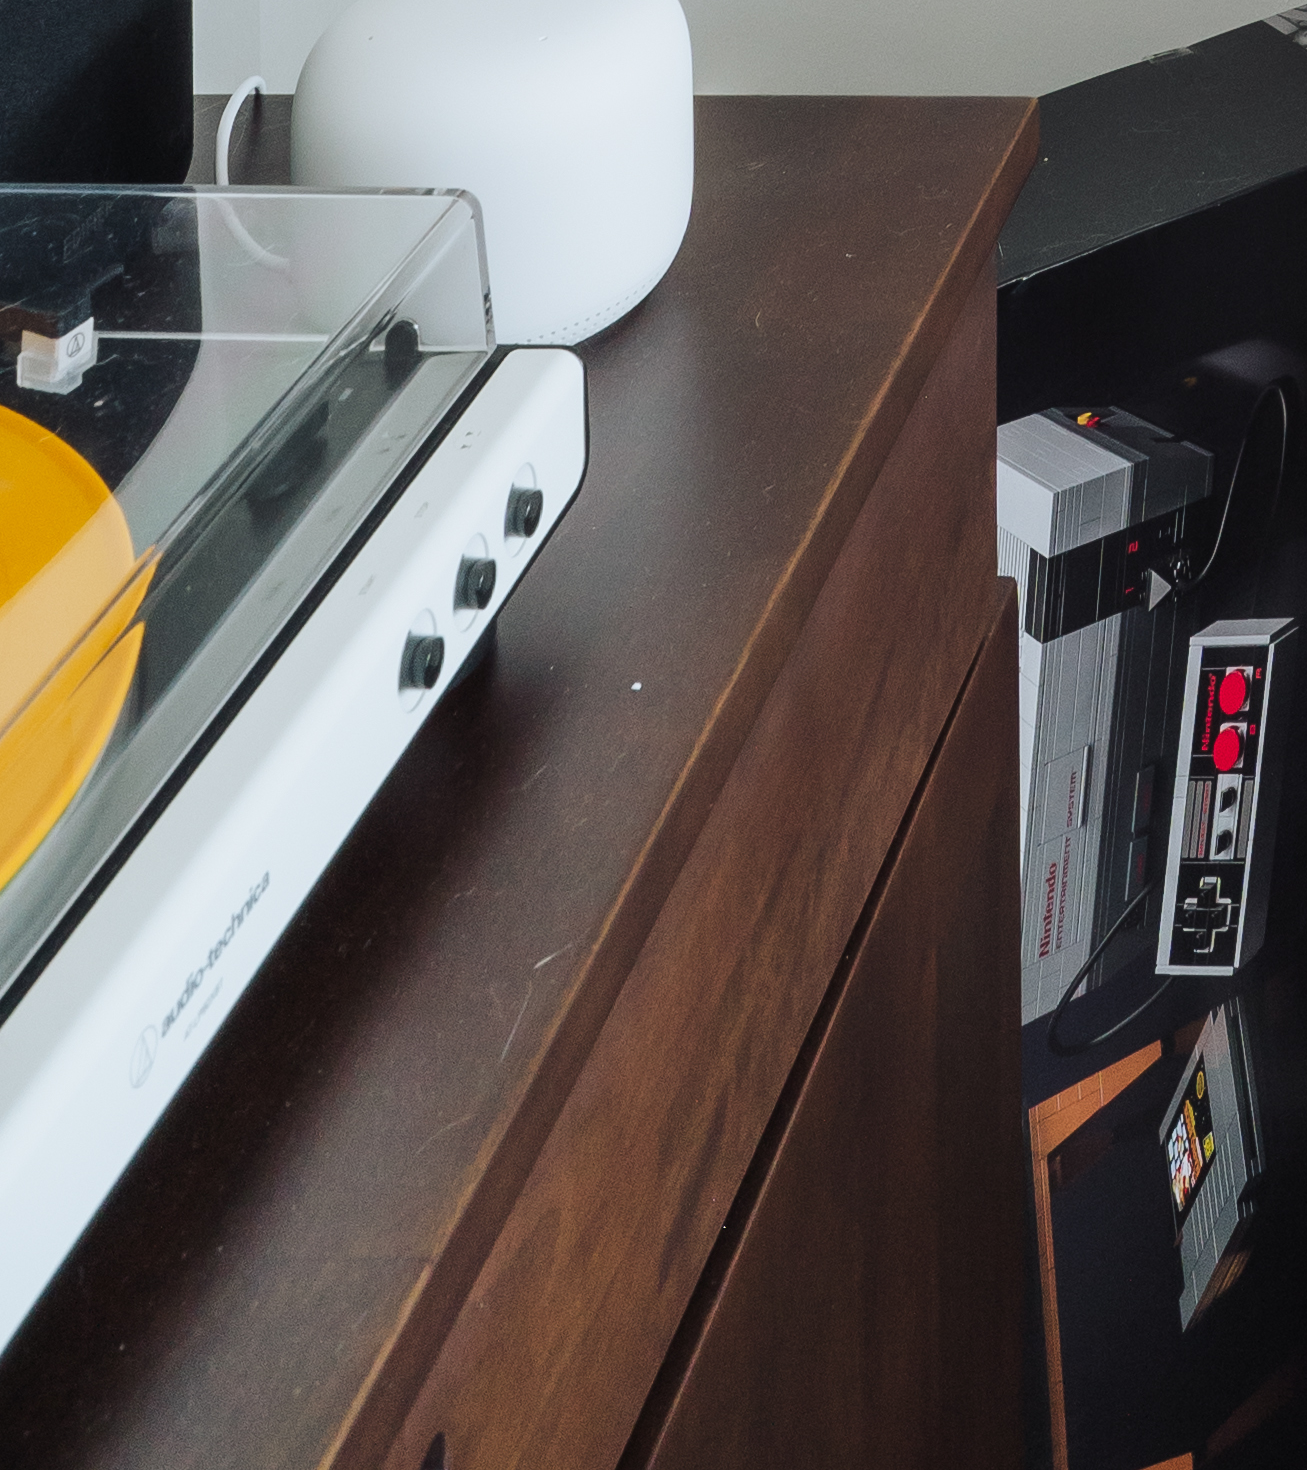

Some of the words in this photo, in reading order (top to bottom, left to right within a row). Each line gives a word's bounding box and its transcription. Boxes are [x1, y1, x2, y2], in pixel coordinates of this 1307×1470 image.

[1201, 672, 1217, 752] Nintendo
[1038, 862, 1057, 959] Nintendo
[1055, 836, 1070, 950] ENTERTAINMENT
[1066, 771, 1077, 829] SYSTEM
[161, 870, 270, 1039] audio-technica
